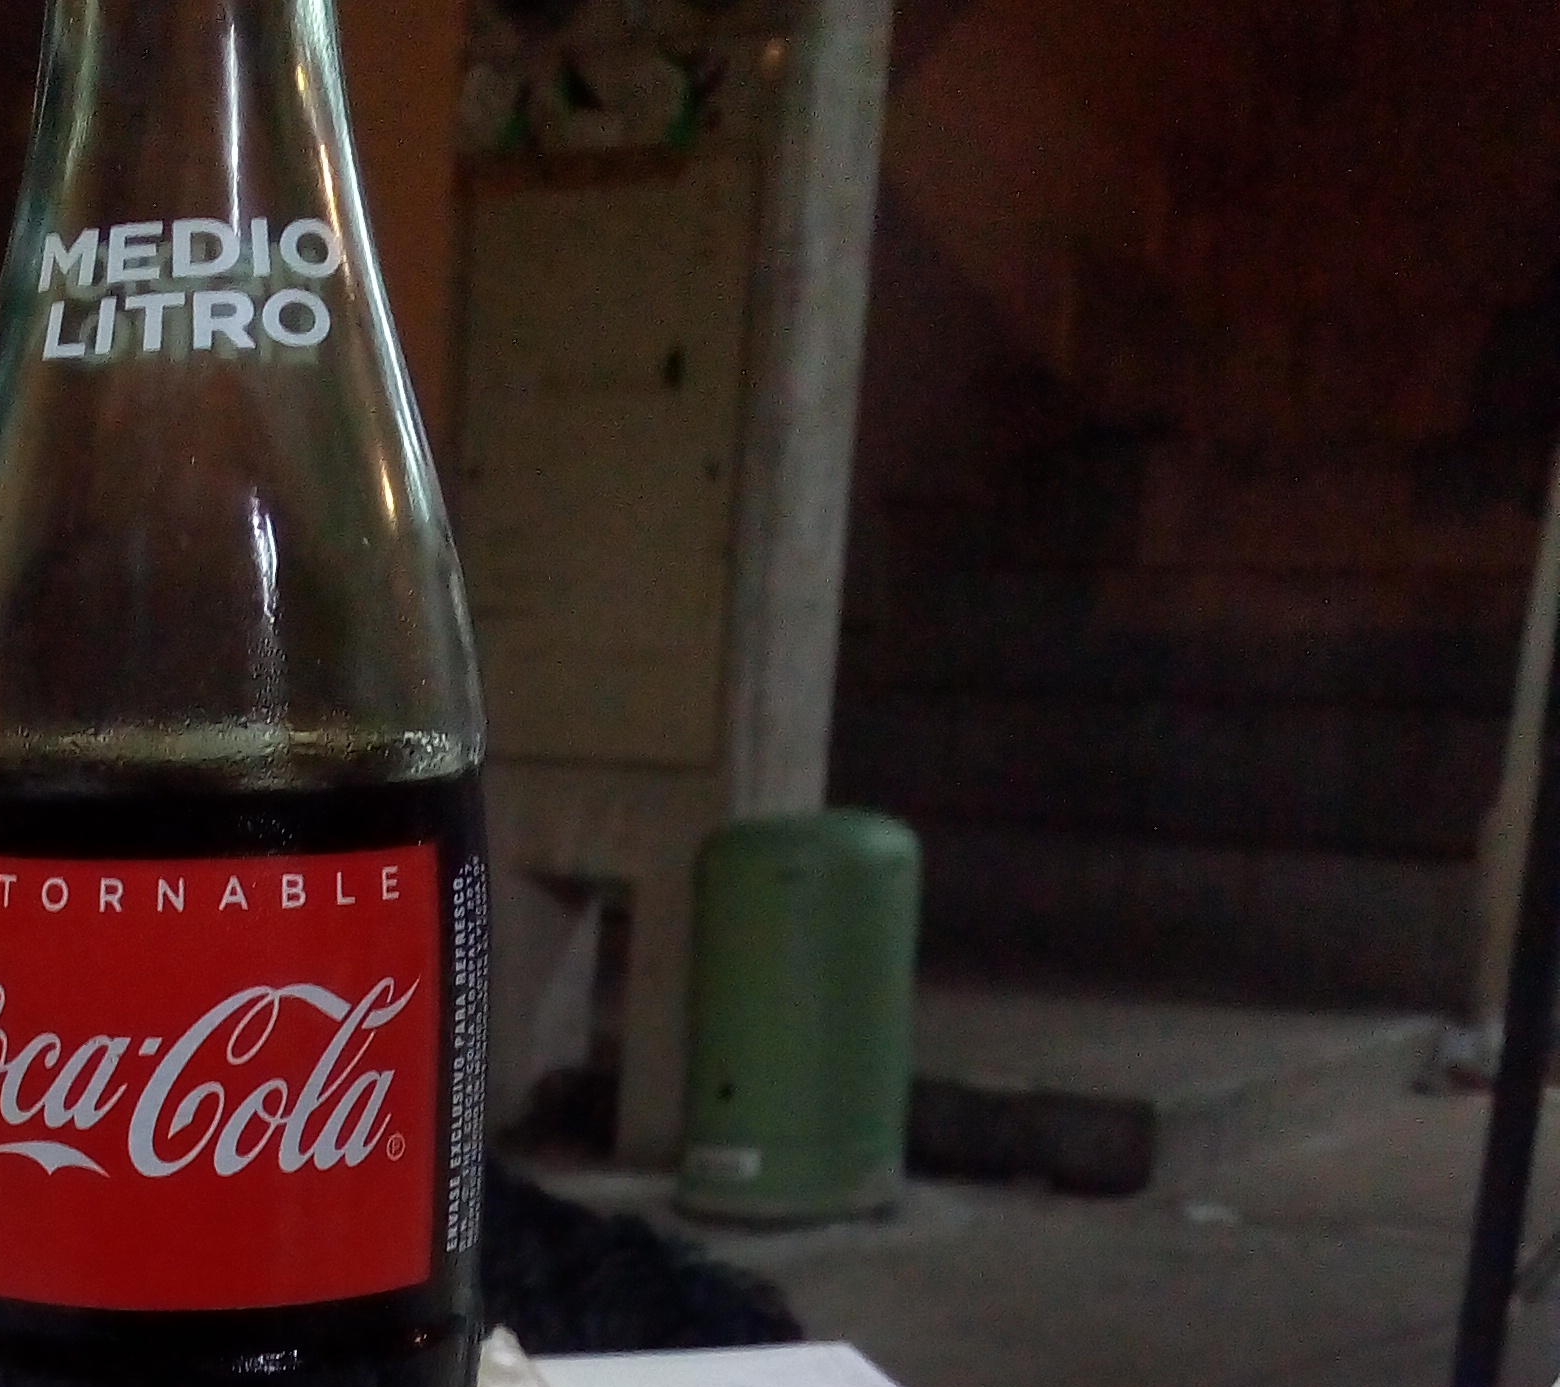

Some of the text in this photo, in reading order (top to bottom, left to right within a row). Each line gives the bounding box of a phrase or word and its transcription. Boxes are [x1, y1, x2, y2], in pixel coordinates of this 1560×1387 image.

[38, 216, 343, 293] MEDIO
[42, 288, 331, 362] LITRO
[453, 994, 467, 1050] PARA
[449, 1056, 465, 1170] EXCLUSIVO
[446, 1175, 461, 1253] ENVASE
